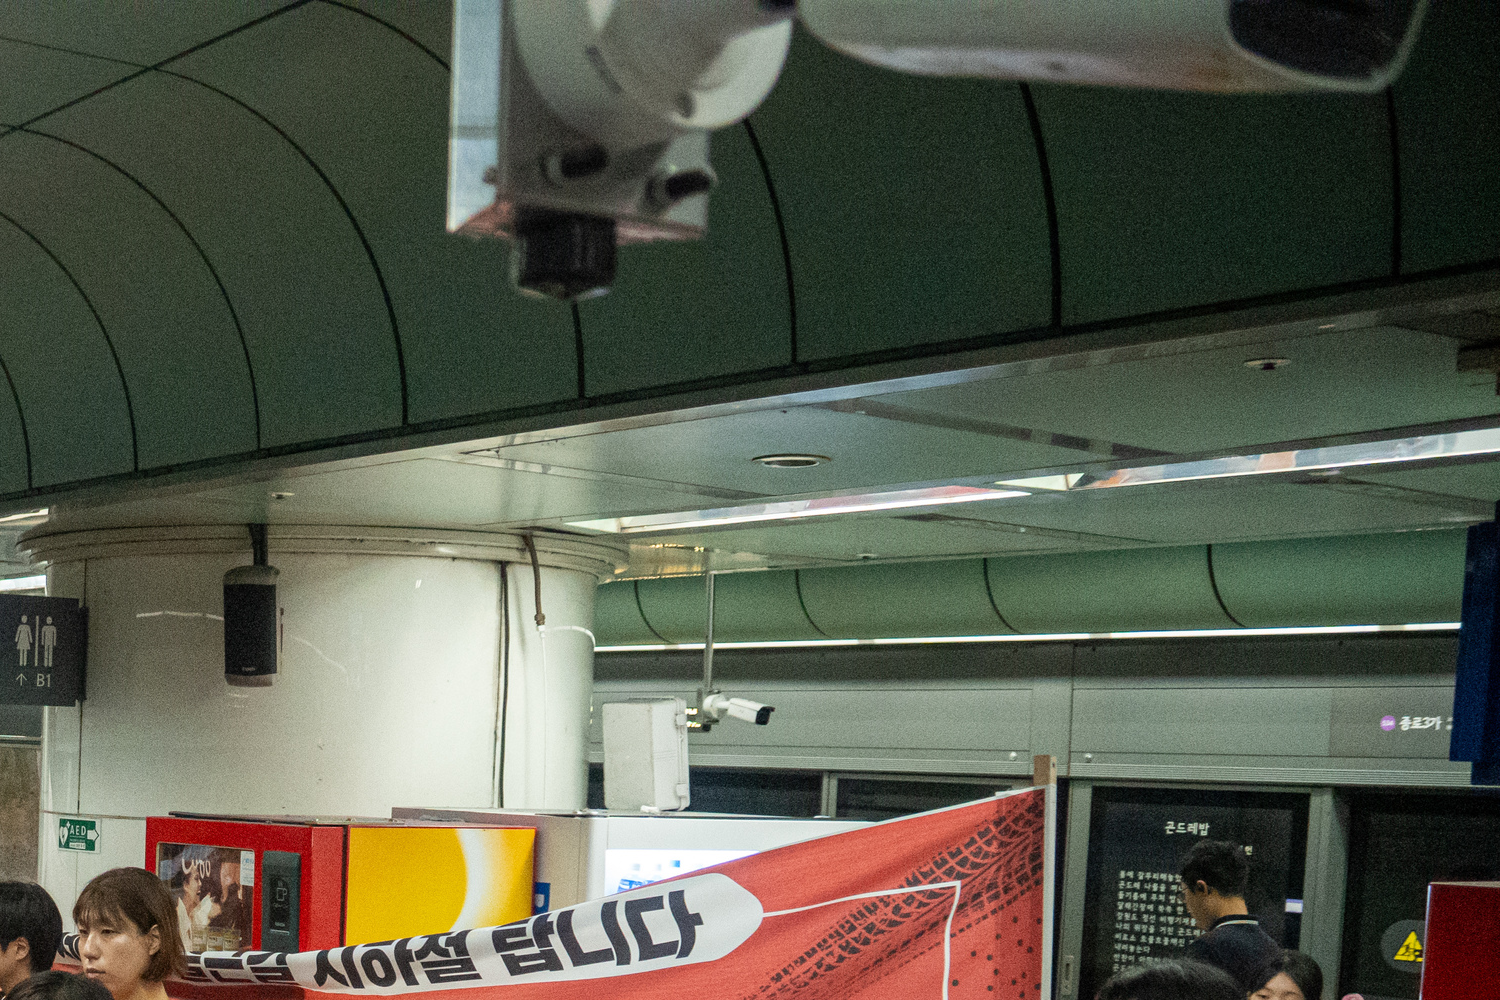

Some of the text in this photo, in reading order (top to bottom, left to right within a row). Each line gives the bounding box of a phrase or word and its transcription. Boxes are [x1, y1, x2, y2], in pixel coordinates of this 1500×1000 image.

[36, 673, 51, 687] B1
[1399, 715, 1442, 731] 종로3가
[69, 824, 87, 836] AED
[1164, 820, 1210, 836] 곤드레밥
